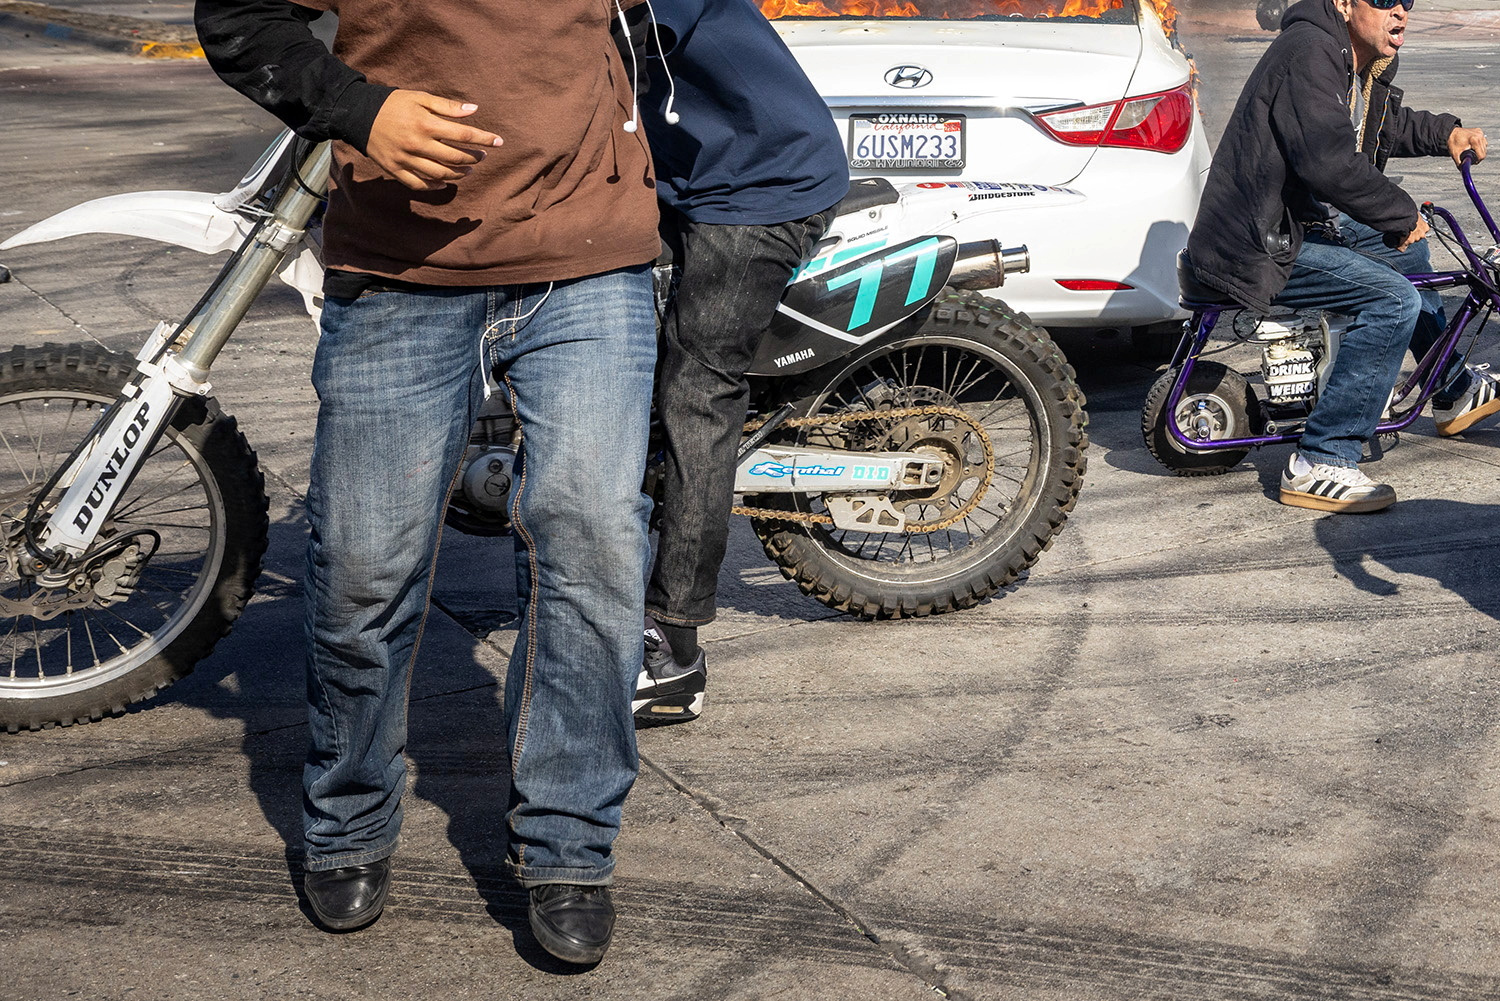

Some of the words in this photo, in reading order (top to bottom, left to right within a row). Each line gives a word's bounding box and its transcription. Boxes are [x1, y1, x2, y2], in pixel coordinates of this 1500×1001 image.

[878, 113, 939, 124] OXNARD
[856, 134, 958, 159] 6USM233
[968, 191, 1036, 202] BRIDGESTONE
[846, 233, 866, 244] SQUID
[866, 225, 889, 237] MISSILE
[773, 347, 816, 369] YAMAHA
[1269, 361, 1313, 377] DRINK
[1270, 381, 1314, 397] WEIRD
[72, 401, 151, 535] DUNLOP
[749, 461, 846, 478] Renthal
